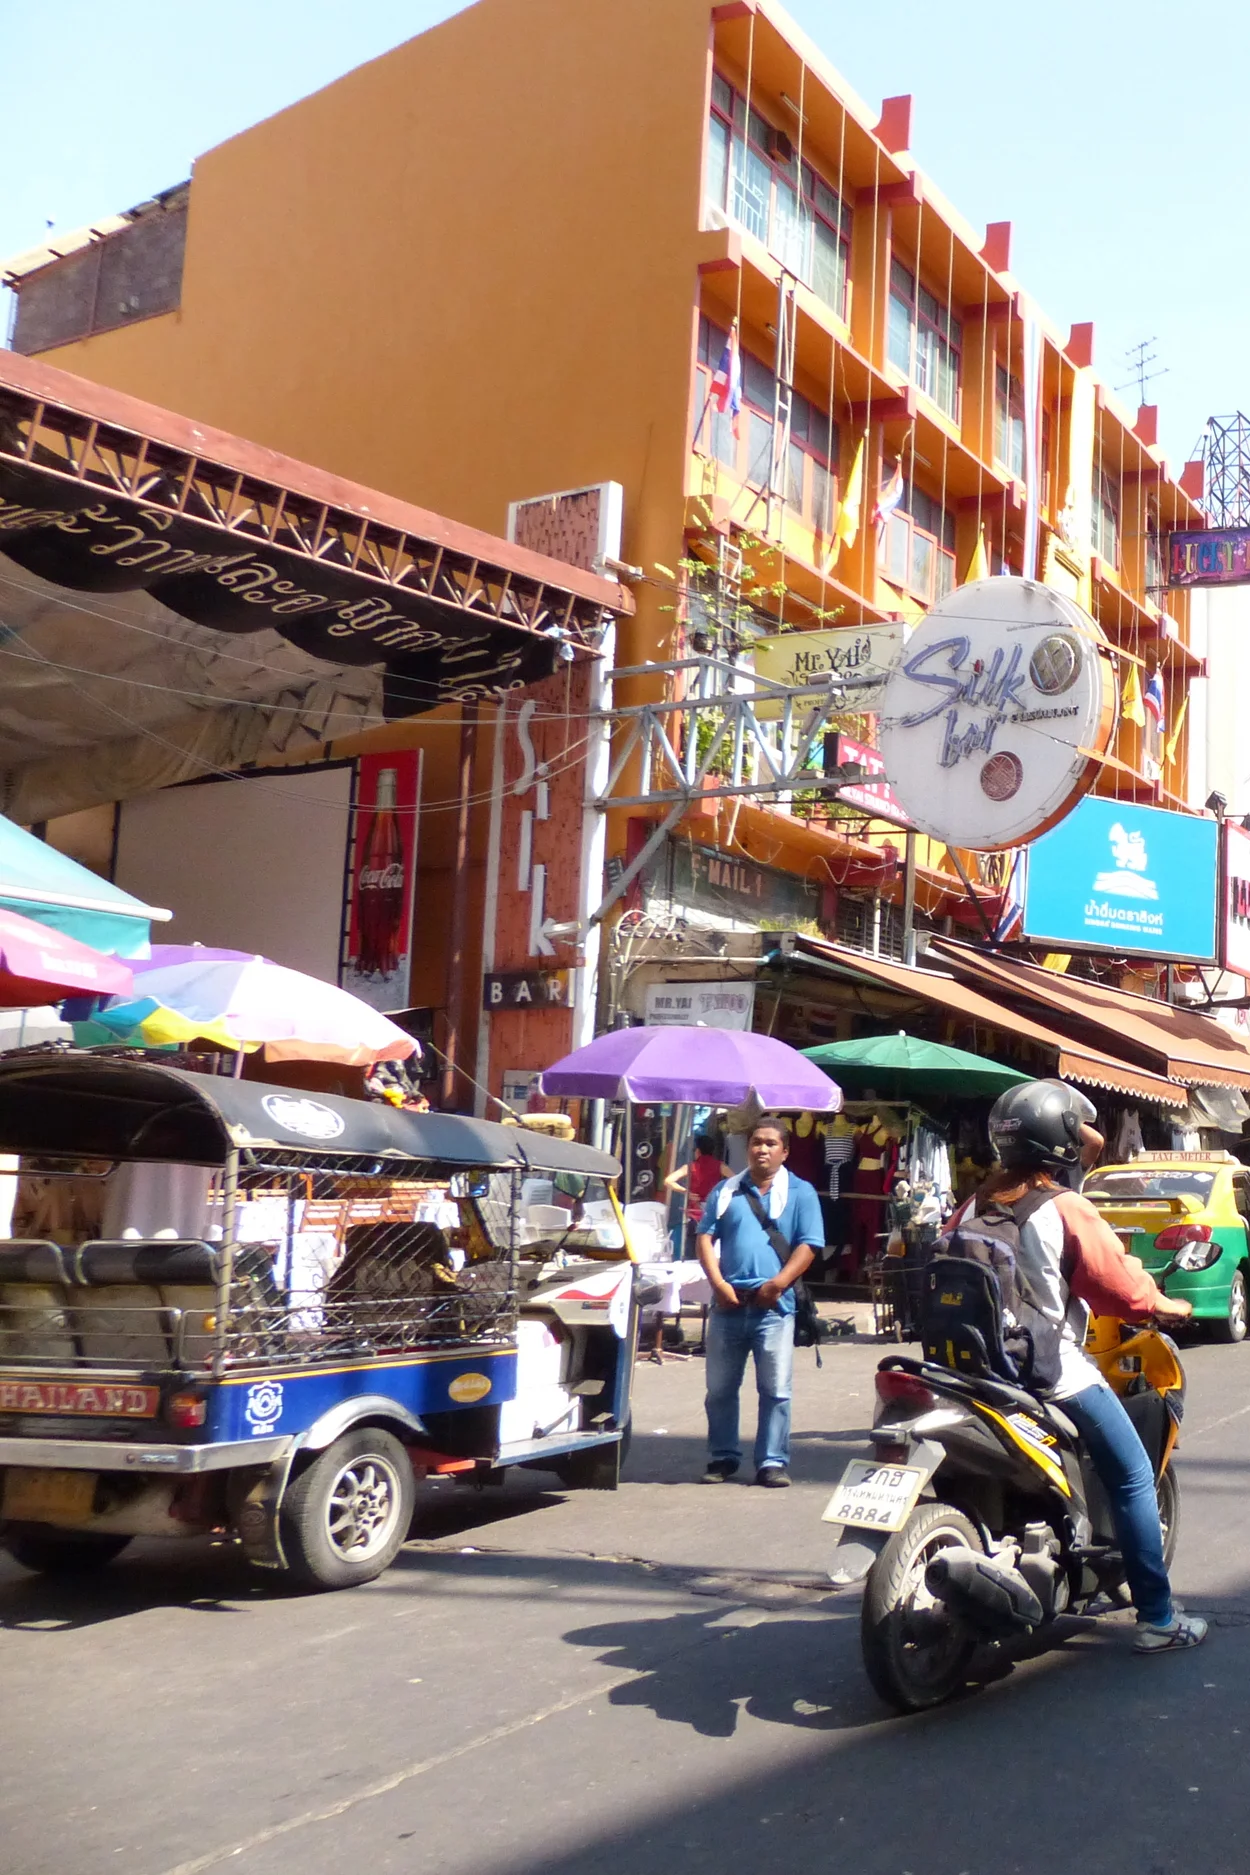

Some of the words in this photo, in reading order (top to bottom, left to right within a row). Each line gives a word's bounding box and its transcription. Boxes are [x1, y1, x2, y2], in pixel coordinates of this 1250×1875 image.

[1172, 541, 1235, 574] LUCKY
[903, 635, 1027, 728] Silk
[491, 980, 562, 1003] BAR
[0, 1385, 148, 1413] HAILAND
[837, 1504, 893, 1524] 8884
